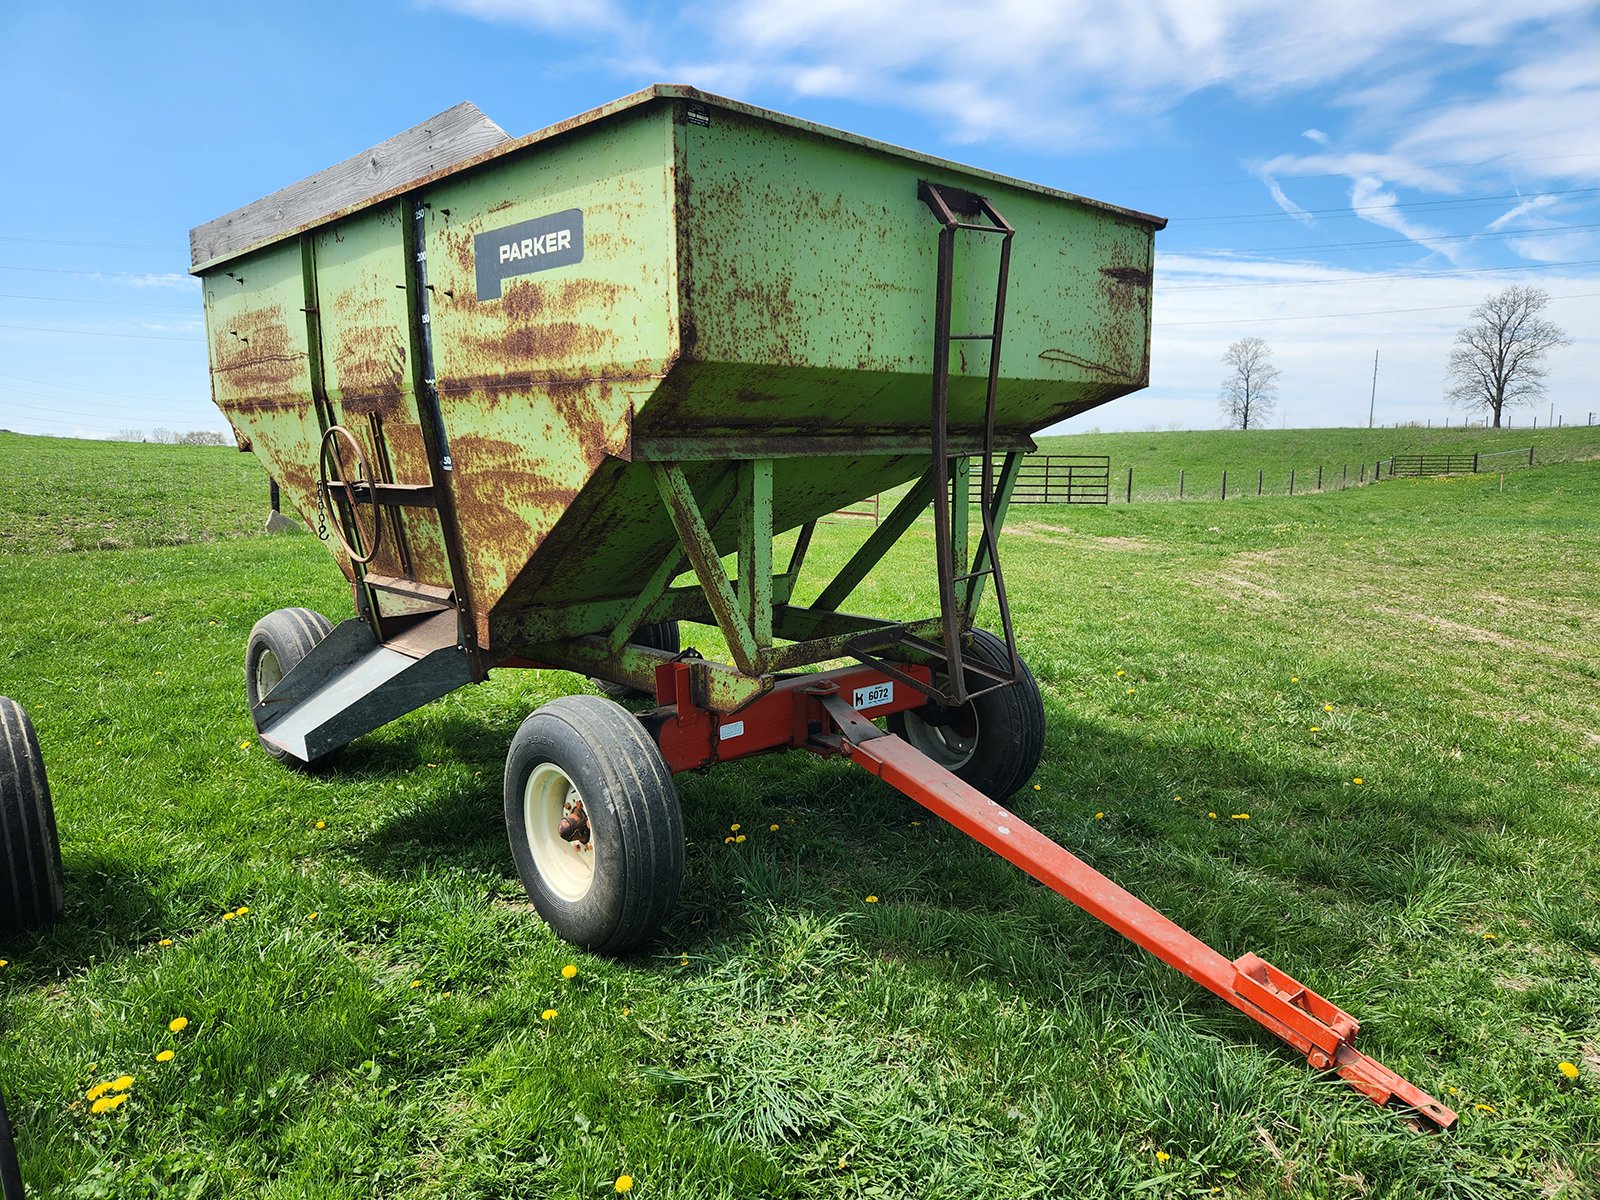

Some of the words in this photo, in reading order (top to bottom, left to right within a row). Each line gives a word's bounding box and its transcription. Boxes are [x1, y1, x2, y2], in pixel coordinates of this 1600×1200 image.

[415, 208, 425, 220] 250
[499, 229, 571, 264] PARKER
[416, 251, 427, 262] 200
[422, 314, 430, 323] 150
[443, 456, 452, 465] 50
[868, 688, 889, 701] 6072
